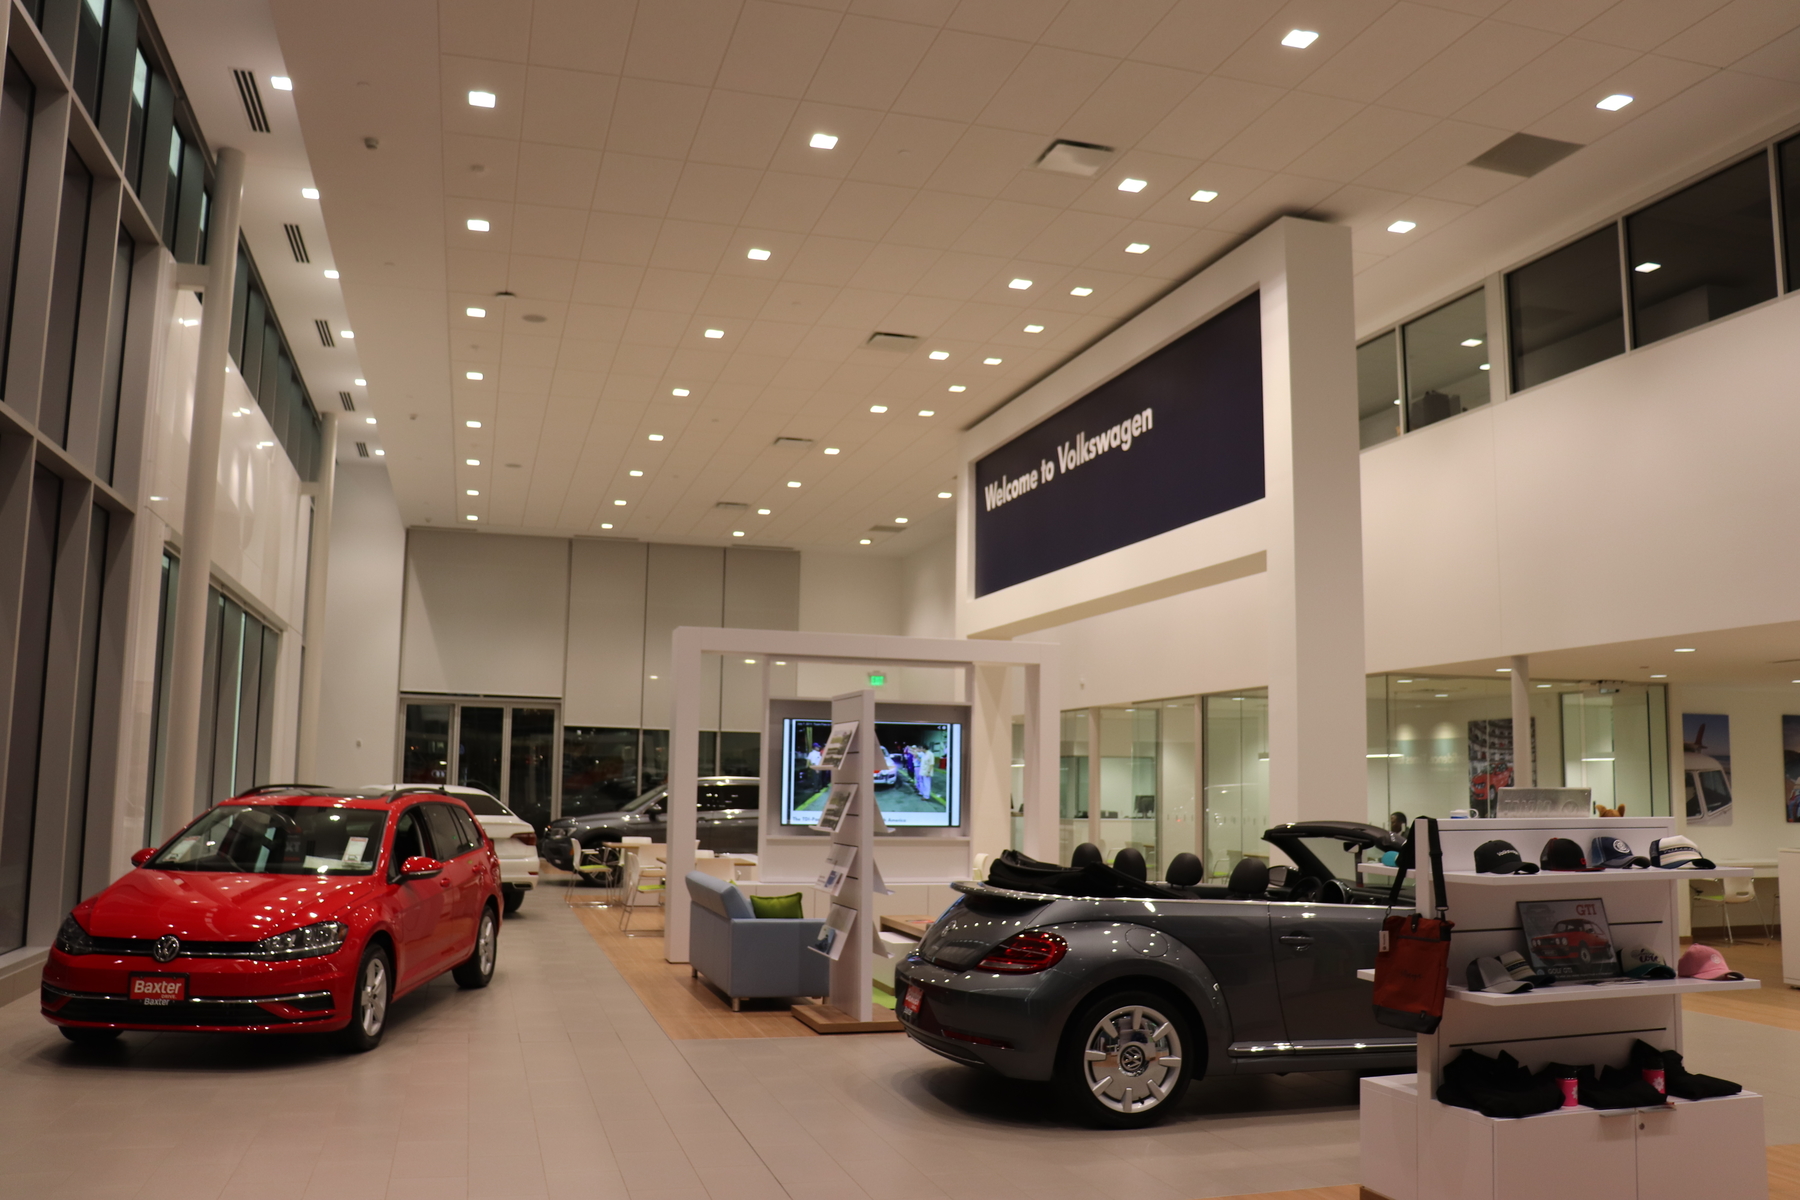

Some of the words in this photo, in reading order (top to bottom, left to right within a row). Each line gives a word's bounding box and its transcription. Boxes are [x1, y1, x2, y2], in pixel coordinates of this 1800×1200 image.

[984, 469, 1038, 512] Welcome
[1041, 458, 1055, 484] to
[1057, 407, 1153, 475] Volkswagen
[1576, 904, 1597, 916] GTI
[134, 980, 182, 994] Baxter
[144, 998, 170, 1006] Baxter
